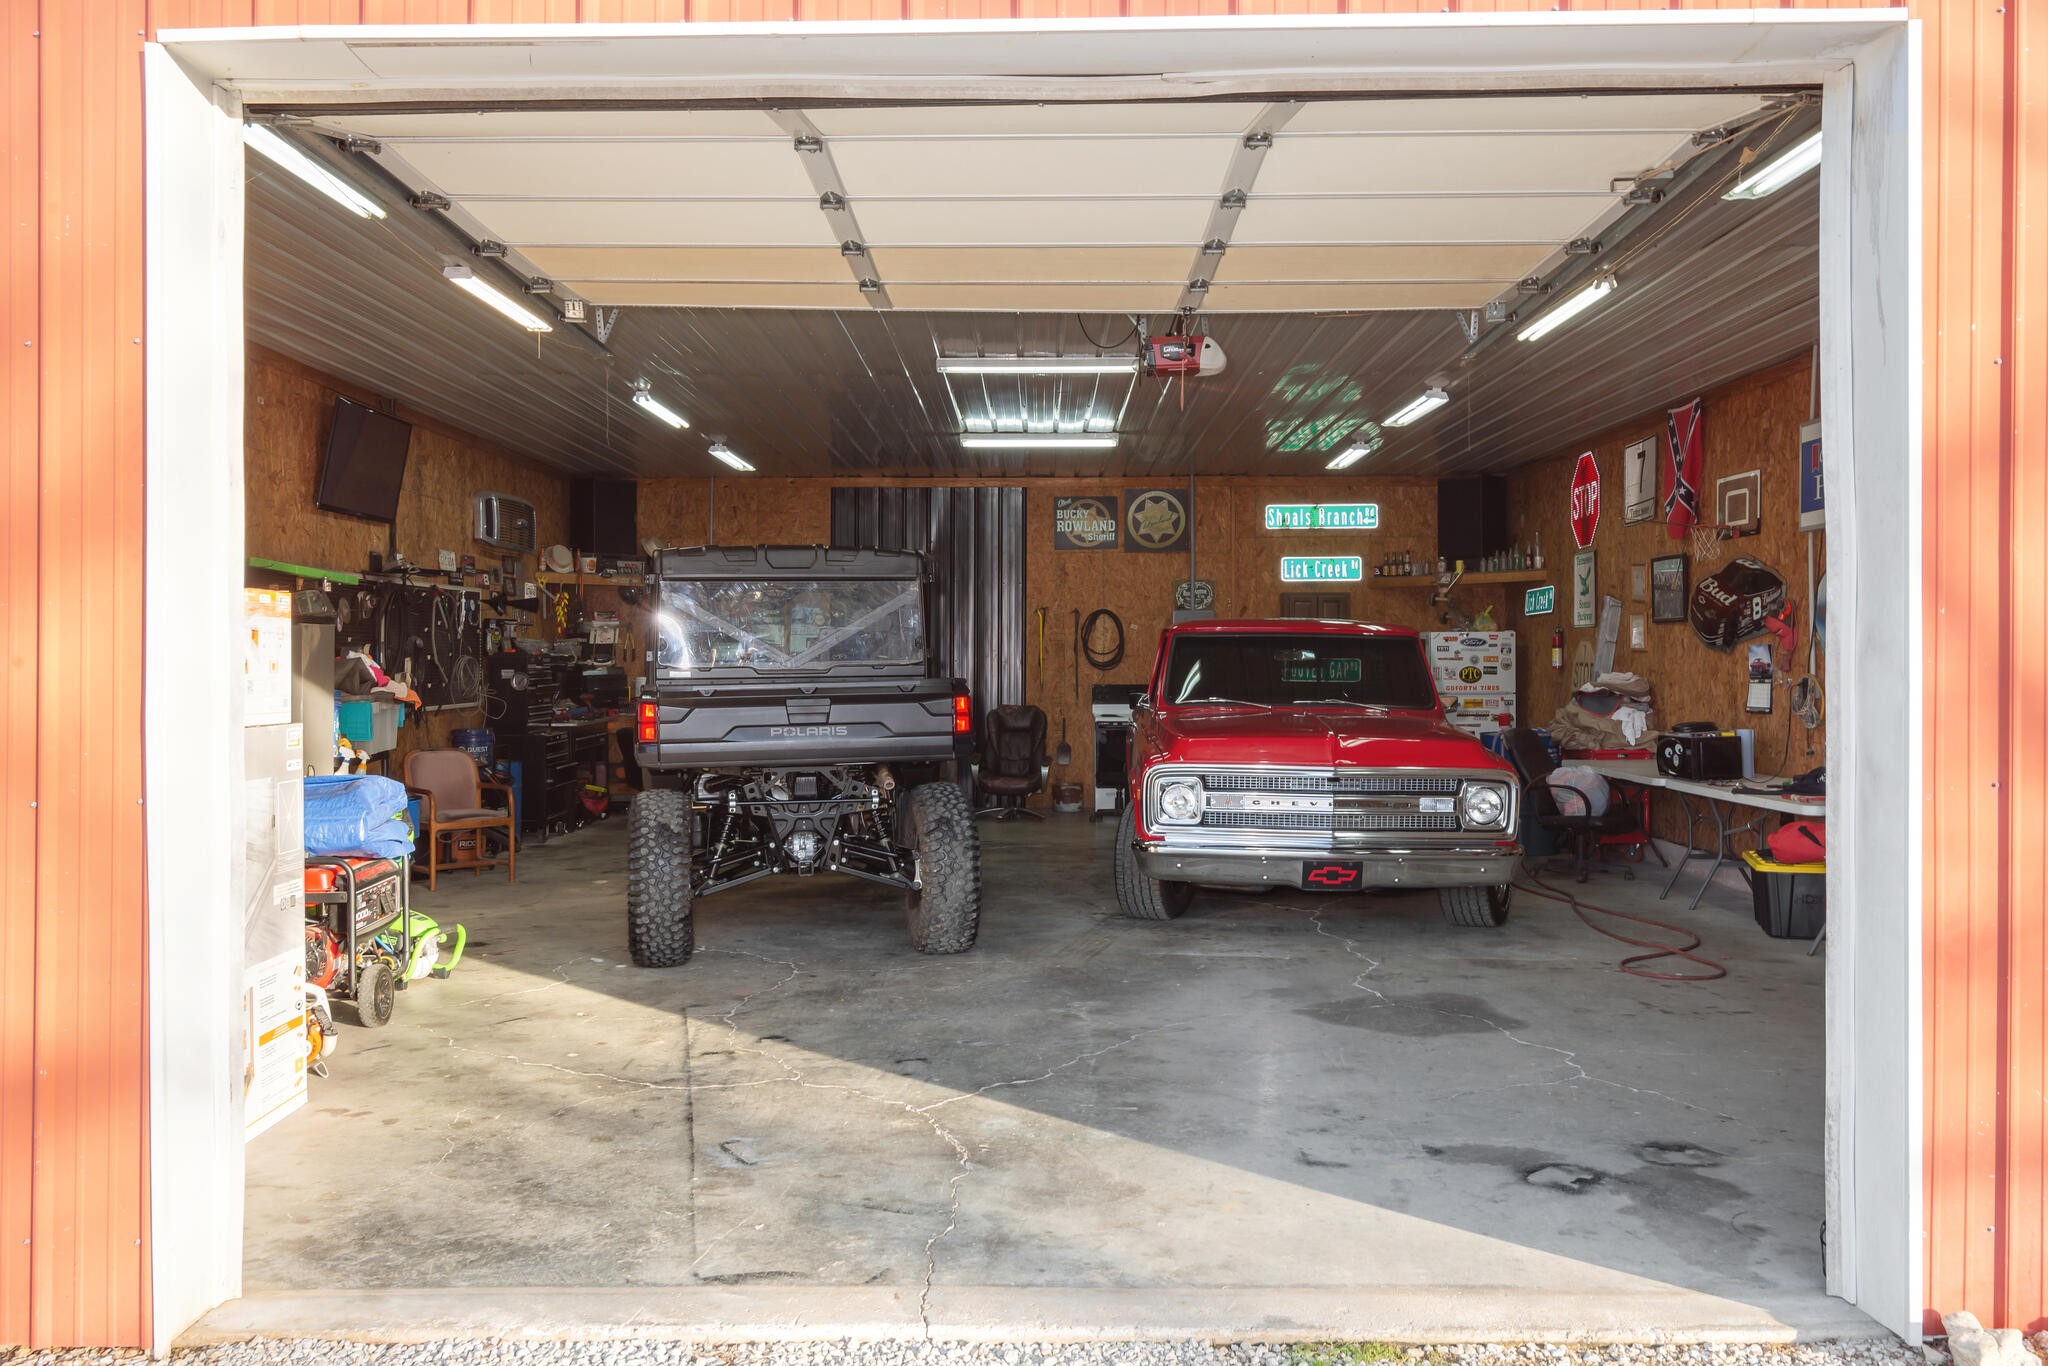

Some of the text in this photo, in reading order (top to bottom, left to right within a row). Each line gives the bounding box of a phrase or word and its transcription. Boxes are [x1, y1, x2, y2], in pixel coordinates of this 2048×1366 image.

[1637, 450, 1646, 494] 7
[1573, 480, 1598, 521] STOP
[1056, 509, 1090, 520] BUCKY
[1268, 507, 1375, 527] Shoals Branch Rd
[1056, 520, 1117, 533] ROWLAND
[1088, 532, 1116, 542] Sheriff
[1283, 560, 1309, 579] Lick
[1314, 560, 1348, 579] Creek
[1700, 577, 1738, 606] Bud
[1752, 596, 1762, 621] 8
[1329, 661, 1349, 679] GAP
[1461, 667, 1481, 681] PTC
[770, 726, 848, 737] POLARIS
